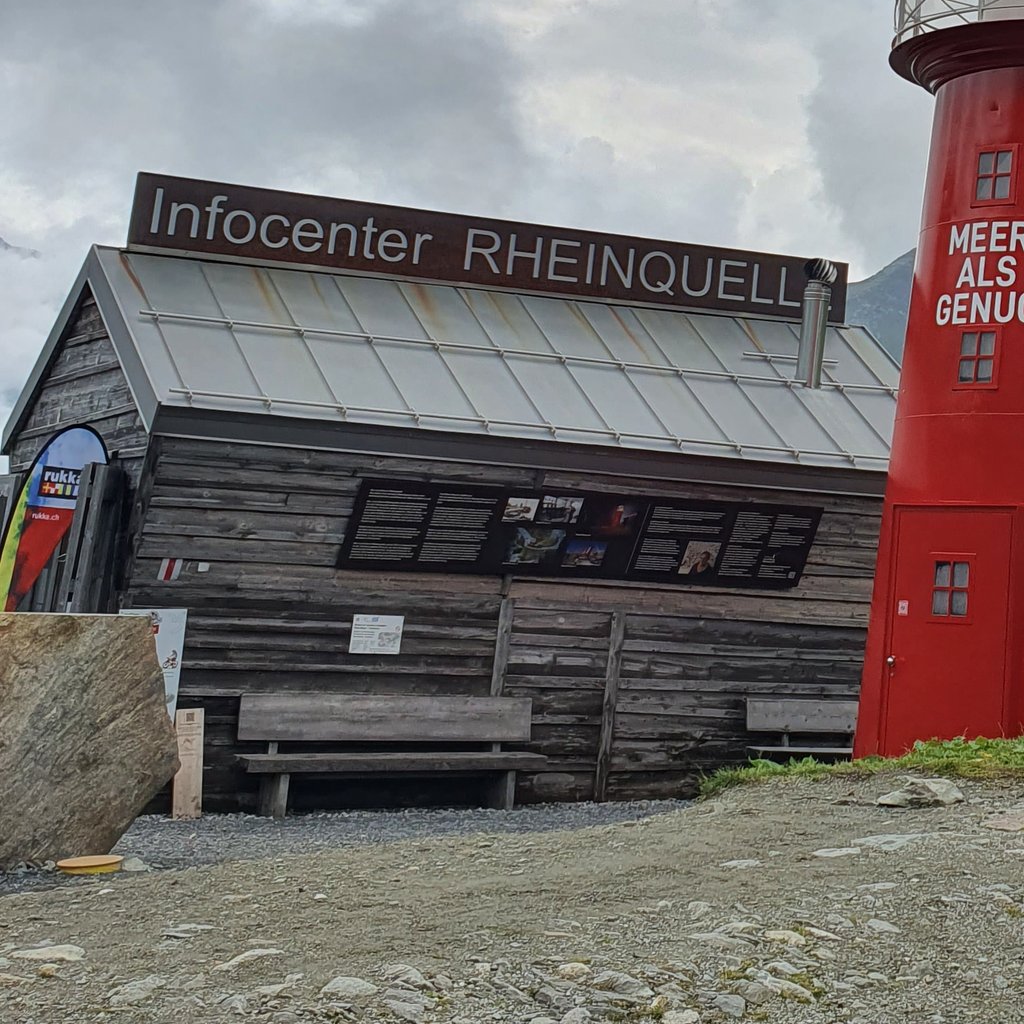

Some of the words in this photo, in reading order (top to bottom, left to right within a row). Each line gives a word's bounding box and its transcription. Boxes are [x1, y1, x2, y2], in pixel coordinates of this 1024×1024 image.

[150, 187, 433, 265] Infocenter
[463, 227, 832, 311] RHEINQUELL
[955, 255, 1017, 288] ALS
